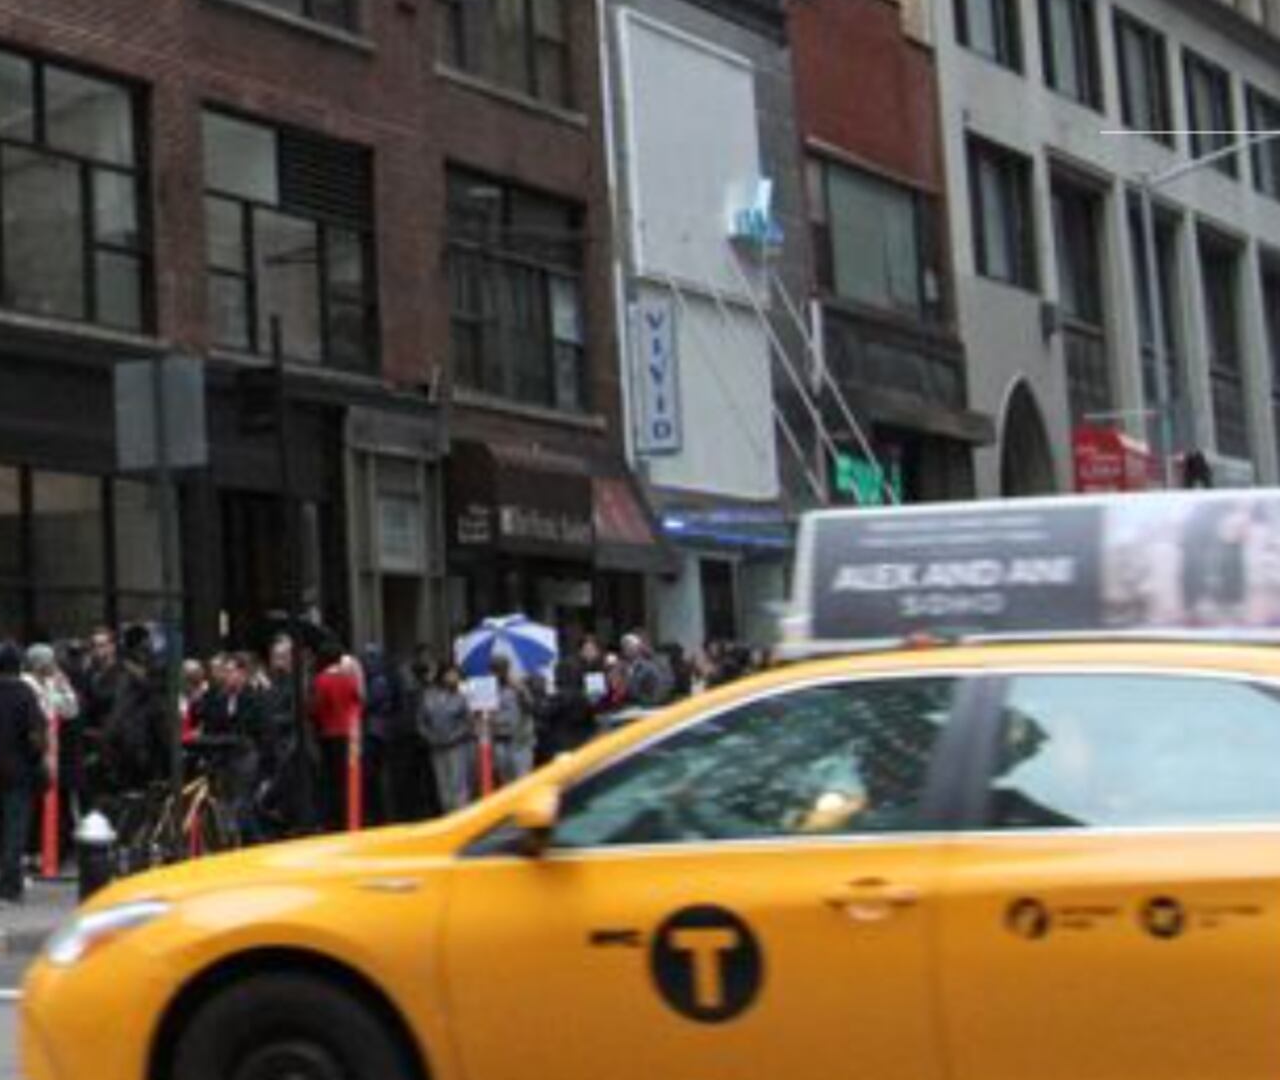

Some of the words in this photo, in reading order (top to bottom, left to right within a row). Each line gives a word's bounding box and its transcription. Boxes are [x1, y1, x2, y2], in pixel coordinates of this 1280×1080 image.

[645, 308, 674, 440] VIVID
[831, 564, 920, 591] ALEX
[921, 559, 1004, 588] AND
[897, 591, 1007, 617] SOHO
